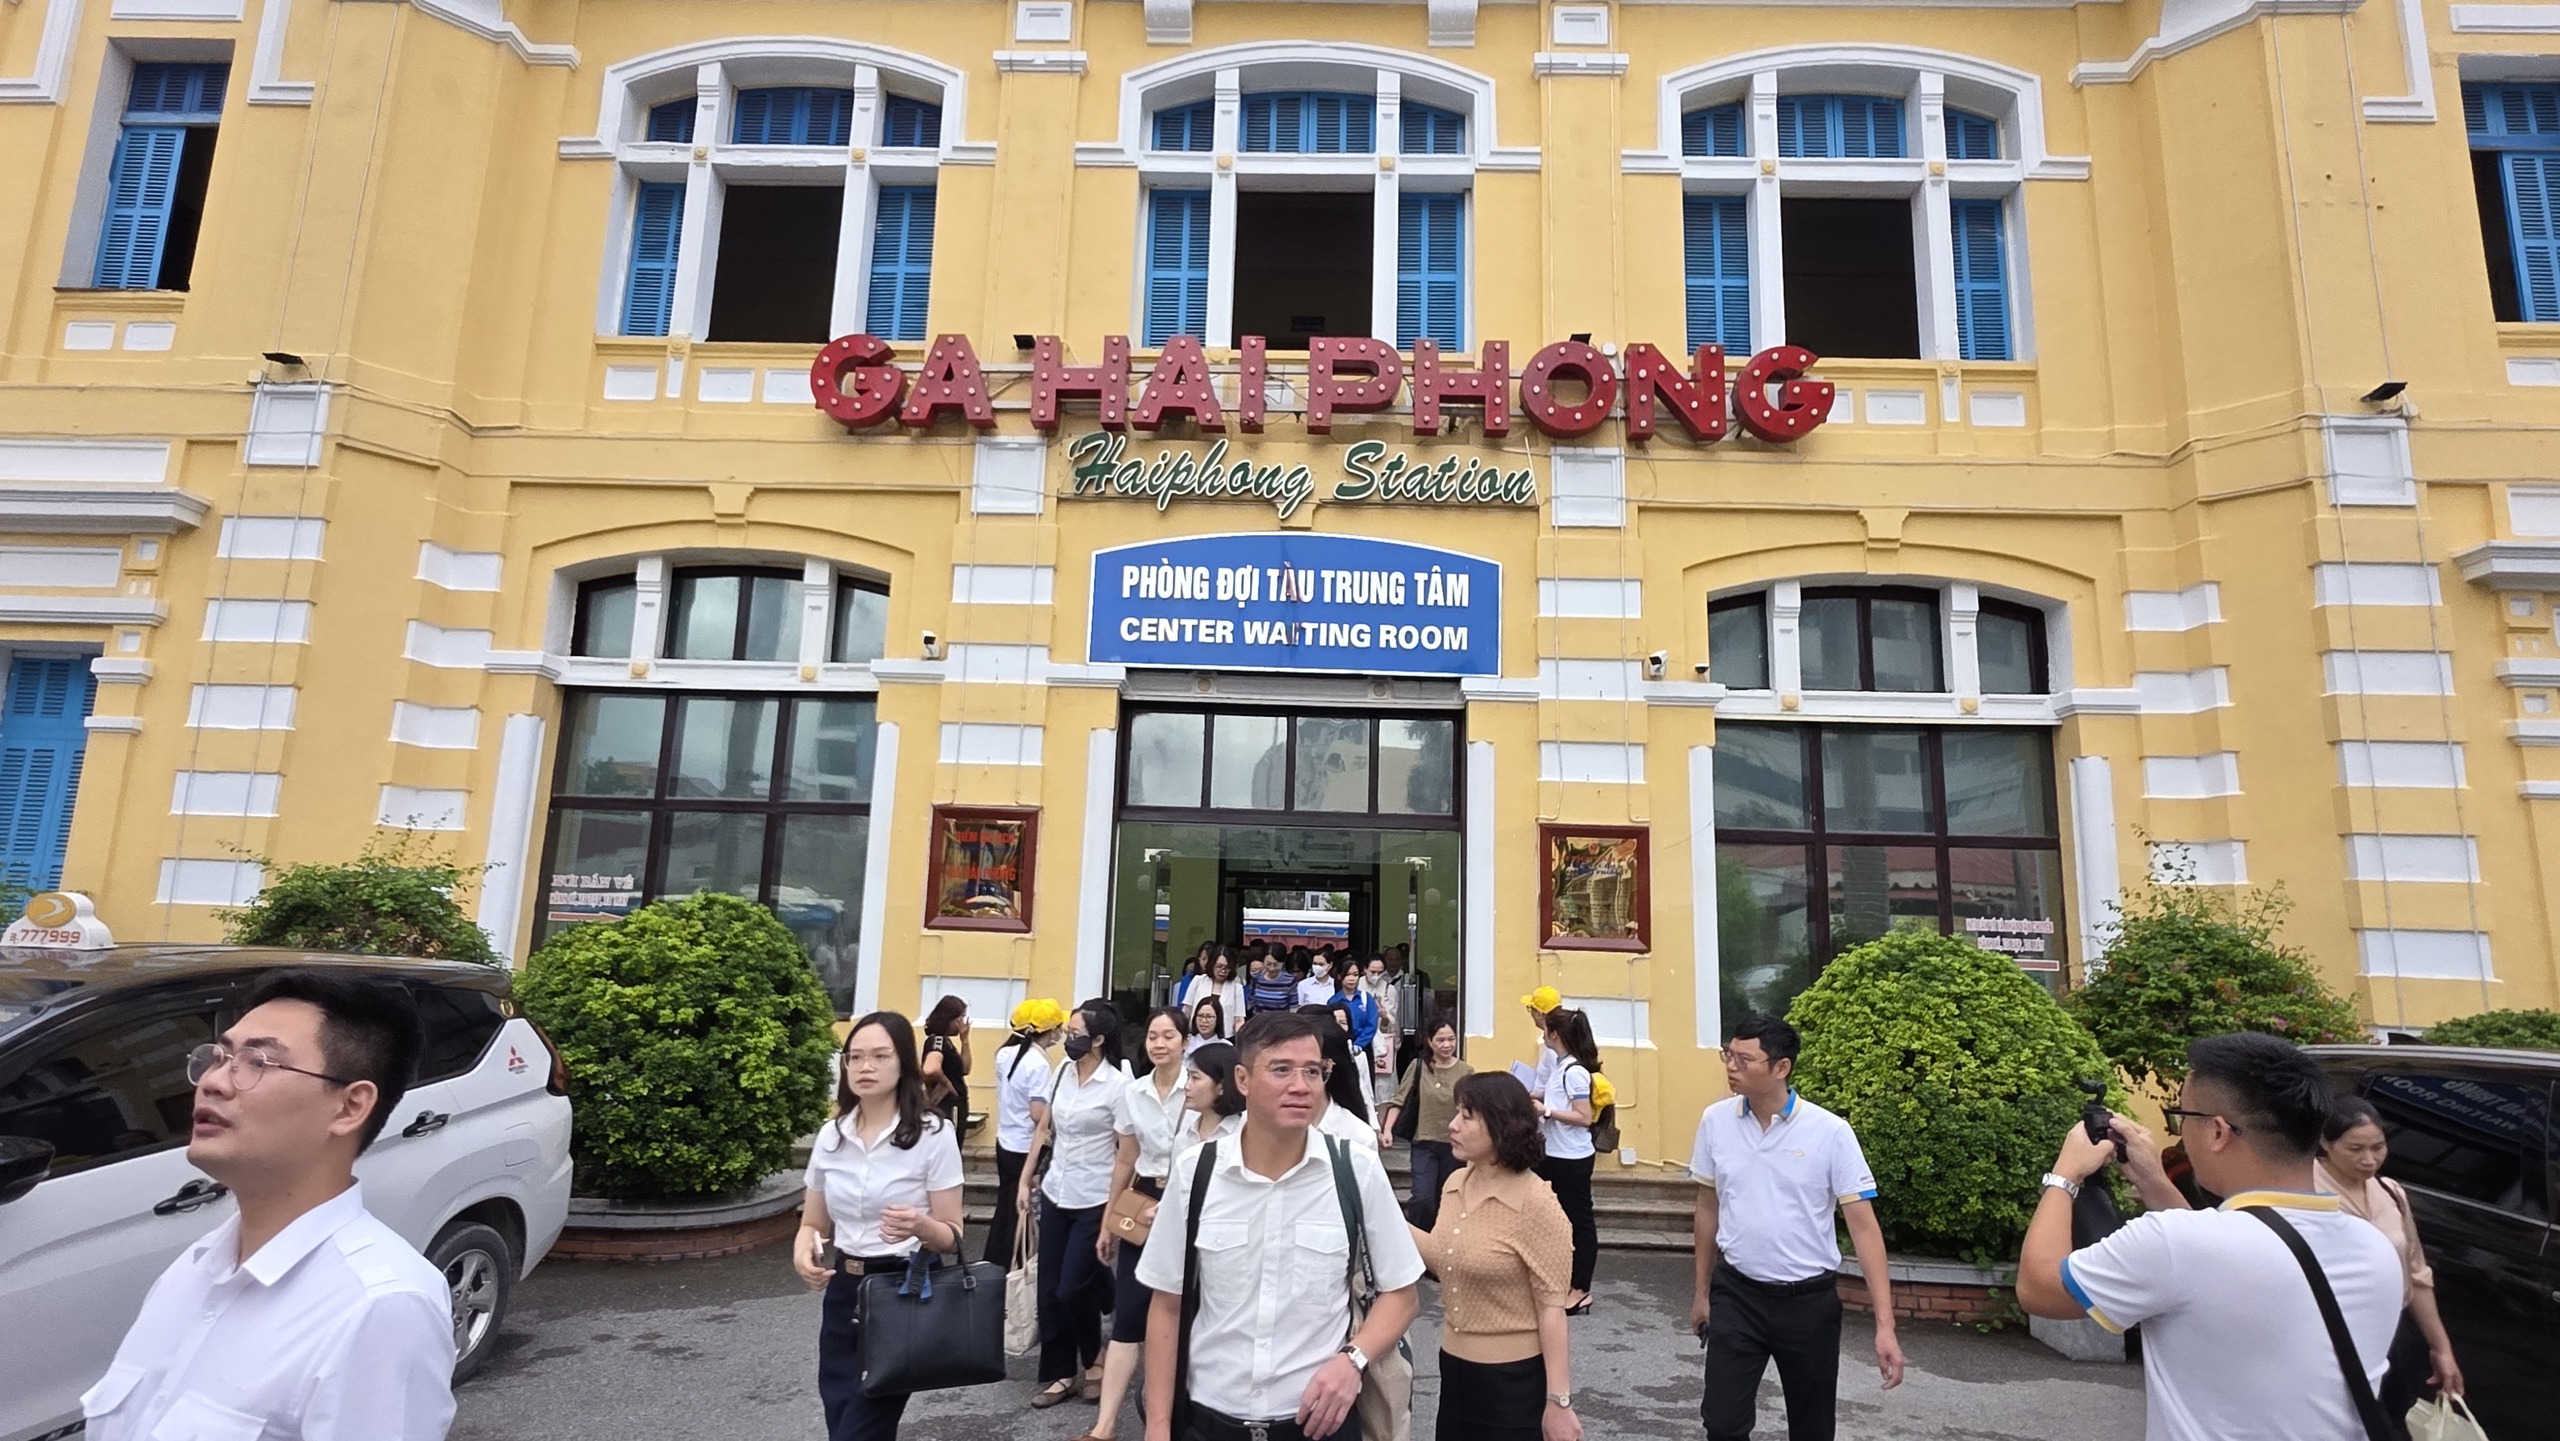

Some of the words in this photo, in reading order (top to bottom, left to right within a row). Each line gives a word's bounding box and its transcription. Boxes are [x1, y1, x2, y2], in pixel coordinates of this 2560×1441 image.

[810, 333, 998, 429] GA
[1030, 335, 1267, 434] HAI
[1308, 336, 1836, 443] PHONG
[1069, 431, 1316, 519] Haiphong
[1332, 439, 1538, 503] Station
[1121, 557, 1210, 601] PHÒNG
[1216, 563, 1261, 609] ĐỢI
[1320, 570, 1406, 606] TRUNG
[1414, 564, 1470, 607] TÂM
[1119, 617, 1234, 643] CENTER
[1378, 624, 1469, 651] ROOM
[20, 929, 81, 944] 777999
